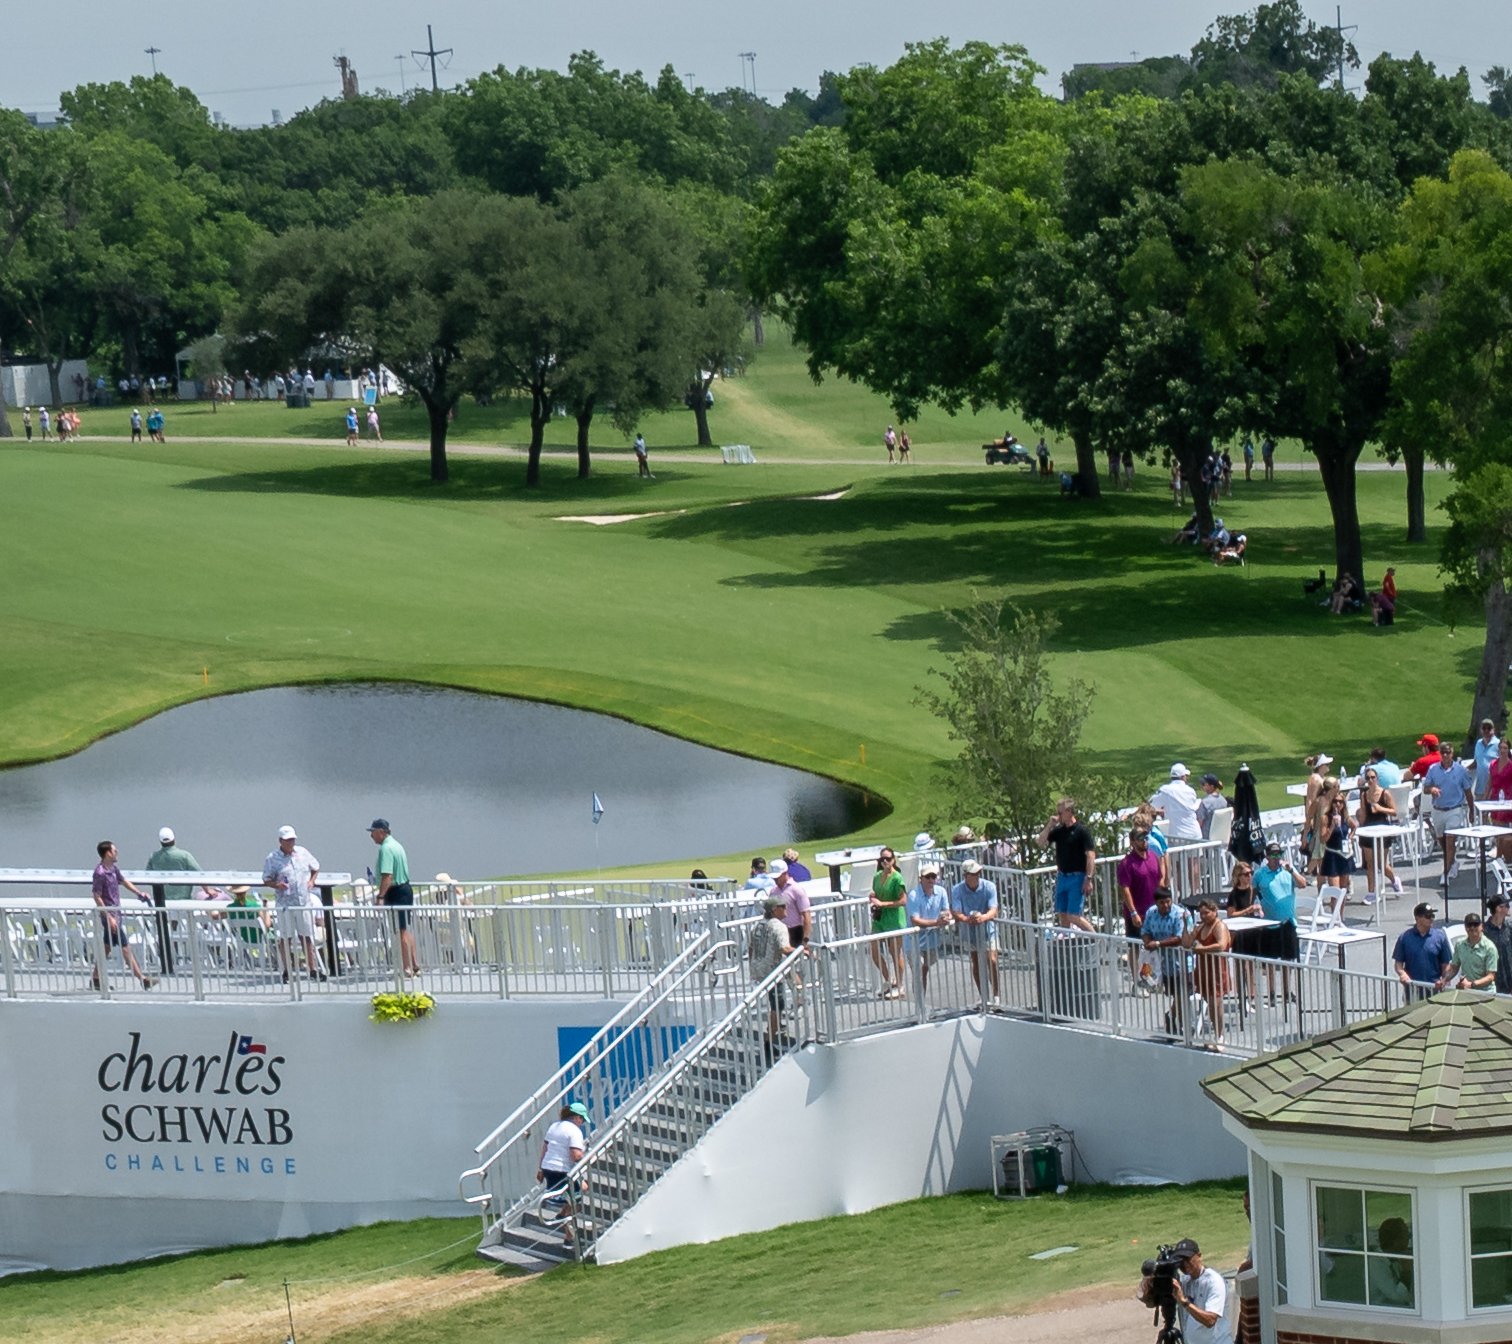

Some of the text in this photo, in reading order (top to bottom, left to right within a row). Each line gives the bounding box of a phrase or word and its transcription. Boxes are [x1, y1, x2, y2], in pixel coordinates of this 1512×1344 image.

[97, 1030, 286, 1096] charles
[101, 1103, 294, 1146] SCHWAB
[105, 1153, 297, 1175] CHALLENGE
